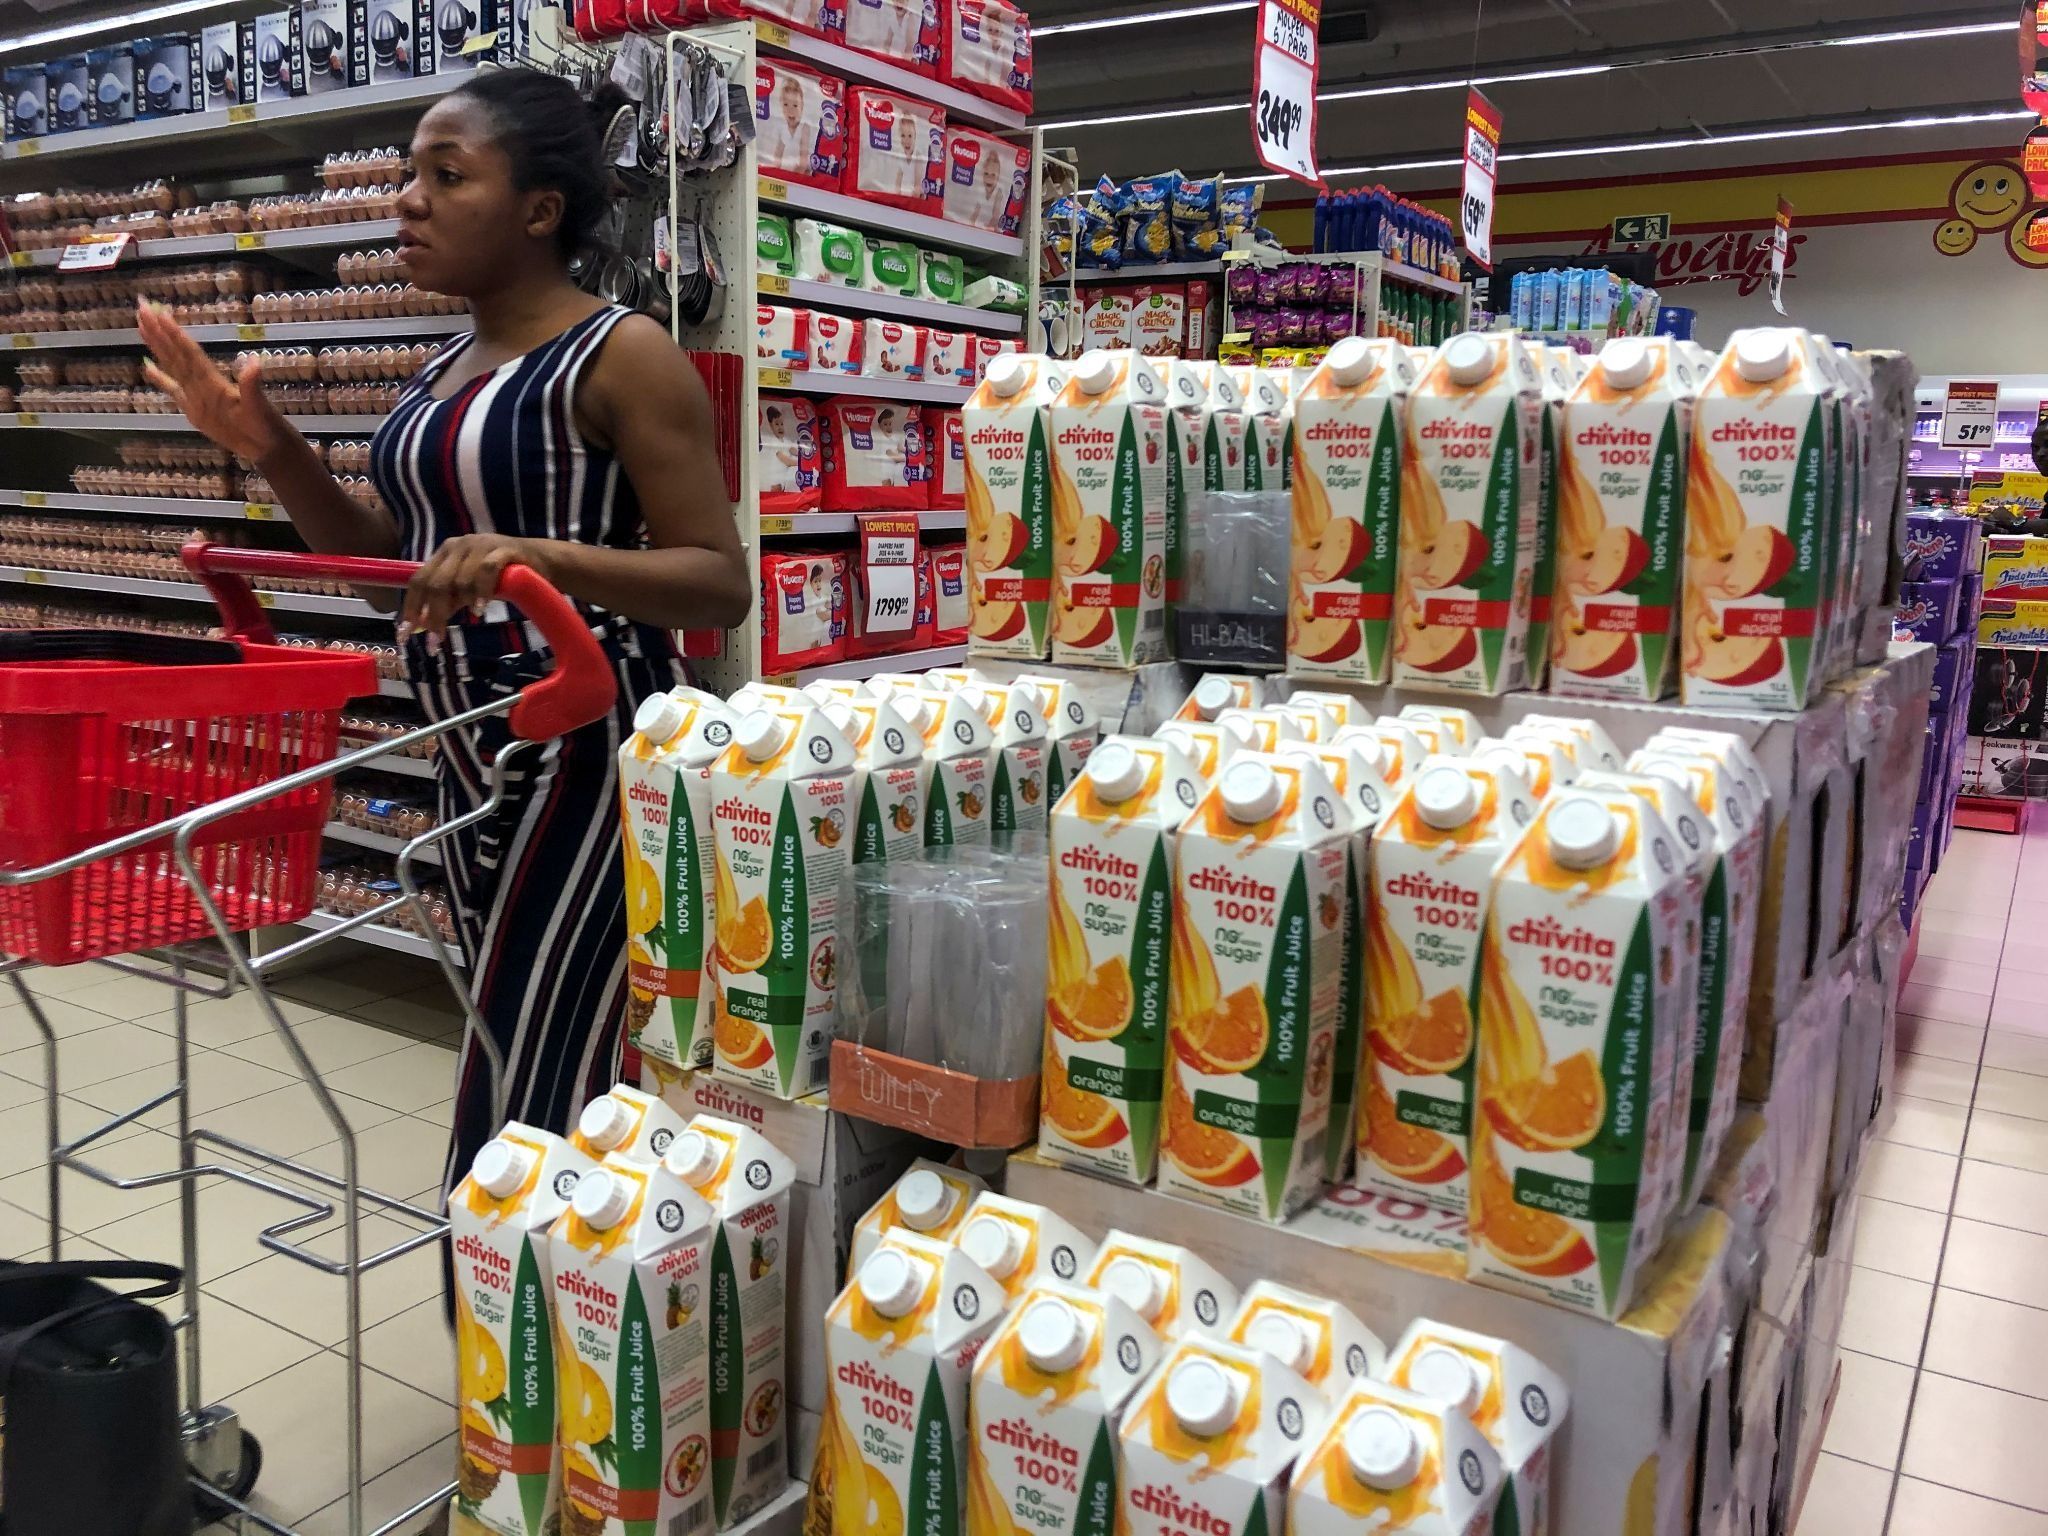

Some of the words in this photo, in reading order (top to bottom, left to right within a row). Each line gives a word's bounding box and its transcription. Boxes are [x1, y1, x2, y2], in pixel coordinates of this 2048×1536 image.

[971, 424, 1024, 445] chivita
[1058, 424, 1114, 445] chivita
[1306, 418, 1372, 440] chivita
[1420, 417, 1492, 440] chivita
[1577, 422, 1651, 446] chivita
[1712, 418, 1796, 443] chivita
[987, 447, 1024, 461] 100%
[1032, 449, 1042, 477] Juice
[1074, 448, 1114, 461] 100%
[1123, 449, 1134, 478] Juice
[1325, 444, 1371, 458] 100%
[1440, 444, 1492, 460] 100%
[1600, 450, 1650, 465] 100%
[1737, 444, 1796, 462] 100%
[988, 476, 1018, 488] sugar
[1077, 477, 1108, 490] sugar
[1739, 482, 1784, 496] sugar
[1032, 480, 1042, 514] Fruit
[1122, 482, 1134, 516] Fruit
[865, 521, 894, 532] LOWEST
[896, 522, 915, 532] PRICE
[1032, 516, 1042, 550] 100%
[1122, 518, 1133, 553] 100%
[1003, 581, 1023, 591] real
[629, 779, 668, 808] chivita
[808, 773, 844, 796] chivita
[820, 792, 846, 806] 100%
[642, 806, 669, 826] 100%
[716, 796, 772, 826] chivita
[676, 816, 687, 852] Juice
[731, 825, 772, 847] 100%
[865, 822, 876, 858] Juice
[932, 808, 944, 844] Juice
[642, 841, 664, 856] sugar
[782, 834, 794, 869] Juice
[1060, 843, 1139, 880] chivita
[676, 855, 688, 894] Fruit
[732, 860, 765, 878] sugar
[782, 873, 794, 912] Fruit
[1083, 876, 1138, 902] 100%
[1188, 865, 1276, 903] chivita
[1386, 871, 1480, 908] chivita
[677, 896, 689, 935] 100%
[1148, 890, 1165, 931] Juice
[1214, 900, 1274, 928] 100%
[1414, 906, 1478, 932] 100%
[782, 916, 794, 960] 100%
[1084, 916, 1127, 936] sugar
[1508, 916, 1617, 959] chivita
[1145, 934, 1161, 978] Fruit
[1214, 944, 1263, 964] sugar
[1538, 954, 1613, 986] 100%
[730, 1002, 768, 1022] orange
[746, 996, 768, 1008] real
[1143, 978, 1159, 1029] 100%
[1626, 972, 1648, 1023] Juice
[1540, 1005, 1599, 1028] sugar
[1622, 1024, 1642, 1076] Fruit
[1072, 1072, 1124, 1096] orange
[1096, 1068, 1124, 1082] real
[695, 1083, 764, 1124] chivita
[1224, 1102, 1256, 1118] real
[1615, 1079, 1636, 1137] 100%
[1198, 1108, 1256, 1133] orange
[1520, 1189, 1590, 1216] orange
[1552, 1182, 1590, 1200] real
[740, 1200, 776, 1229] chivita
[456, 1234, 511, 1274] chivita
[472, 1264, 512, 1294] 100%
[556, 1270, 618, 1309] chivita
[714, 1272, 729, 1308] Juice
[474, 1304, 505, 1325] sugar
[574, 1300, 618, 1332] 100%
[714, 1310, 729, 1348] Fruit
[578, 1341, 612, 1363] sugar
[630, 1320, 643, 1356] Juice
[631, 1359, 644, 1402] Fruit
[716, 1352, 729, 1395] 100%
[838, 1360, 914, 1406] chivita
[632, 1405, 645, 1452] 100%
[860, 1396, 914, 1433] 100%
[864, 1441, 905, 1465] sugar
[926, 1418, 942, 1464] Juice
[986, 1418, 1078, 1468] chivita
[926, 1467, 942, 1510] Fruit
[1014, 1454, 1078, 1494] 100%
[596, 1484, 618, 1499] real
